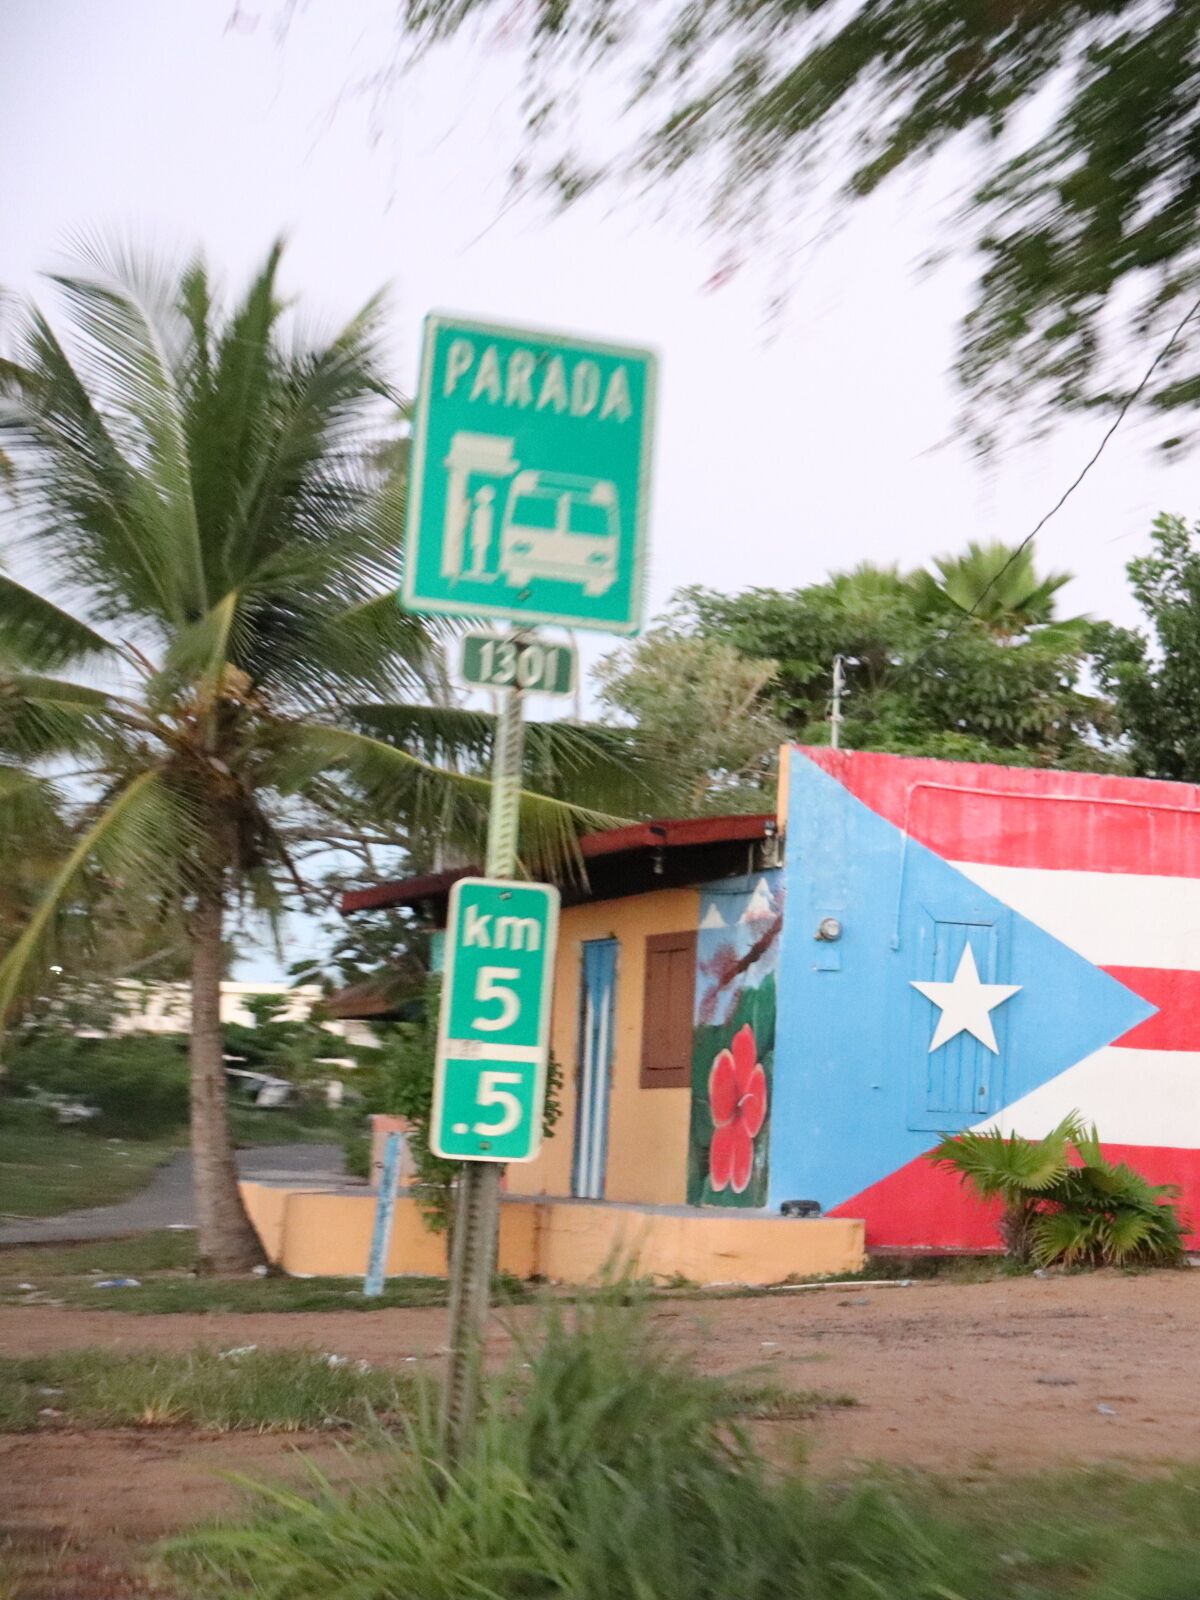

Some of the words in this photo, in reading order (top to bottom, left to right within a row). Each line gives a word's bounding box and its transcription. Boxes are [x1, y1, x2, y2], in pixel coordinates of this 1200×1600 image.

[443, 338, 632, 424] PARADA
[478, 641, 561, 689] 1301
[462, 904, 541, 951] km
[470, 966, 521, 1031] 5
